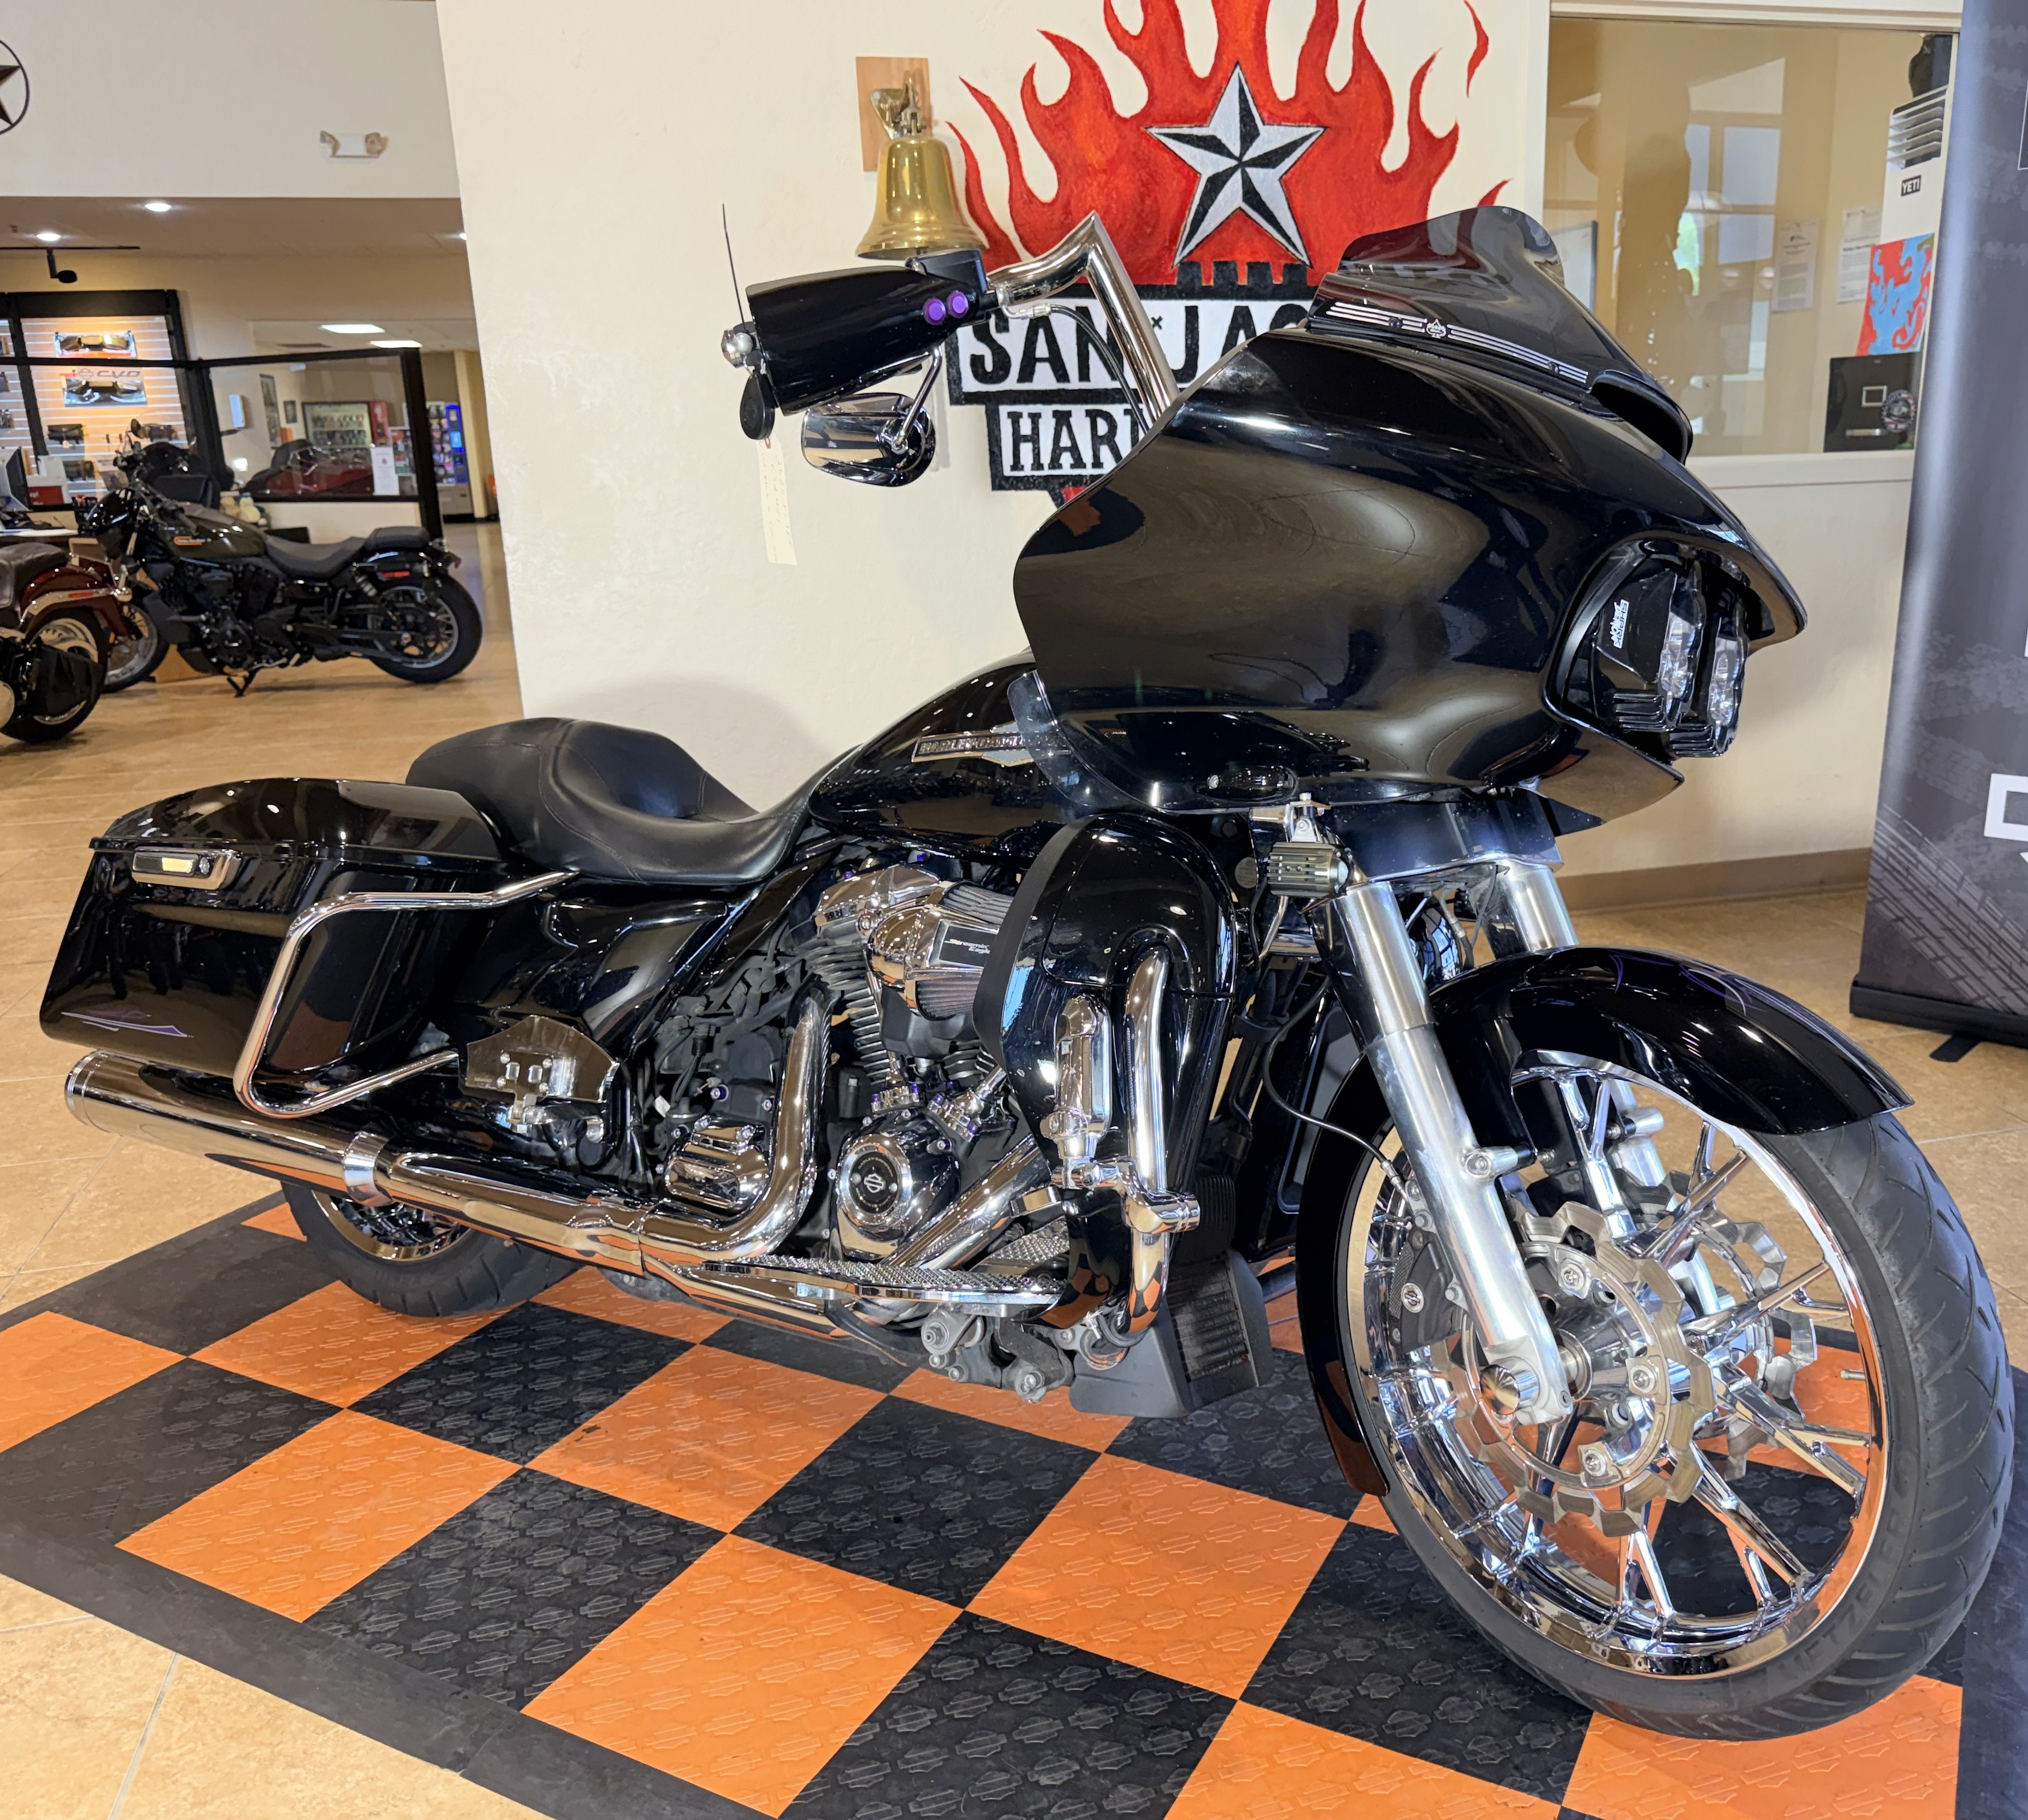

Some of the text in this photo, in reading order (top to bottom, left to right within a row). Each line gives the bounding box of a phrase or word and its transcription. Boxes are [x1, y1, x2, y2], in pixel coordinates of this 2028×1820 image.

[1902, 178, 1920, 194] YETI
[970, 306, 1124, 385] SAN
[96, 370, 141, 379] CVO
